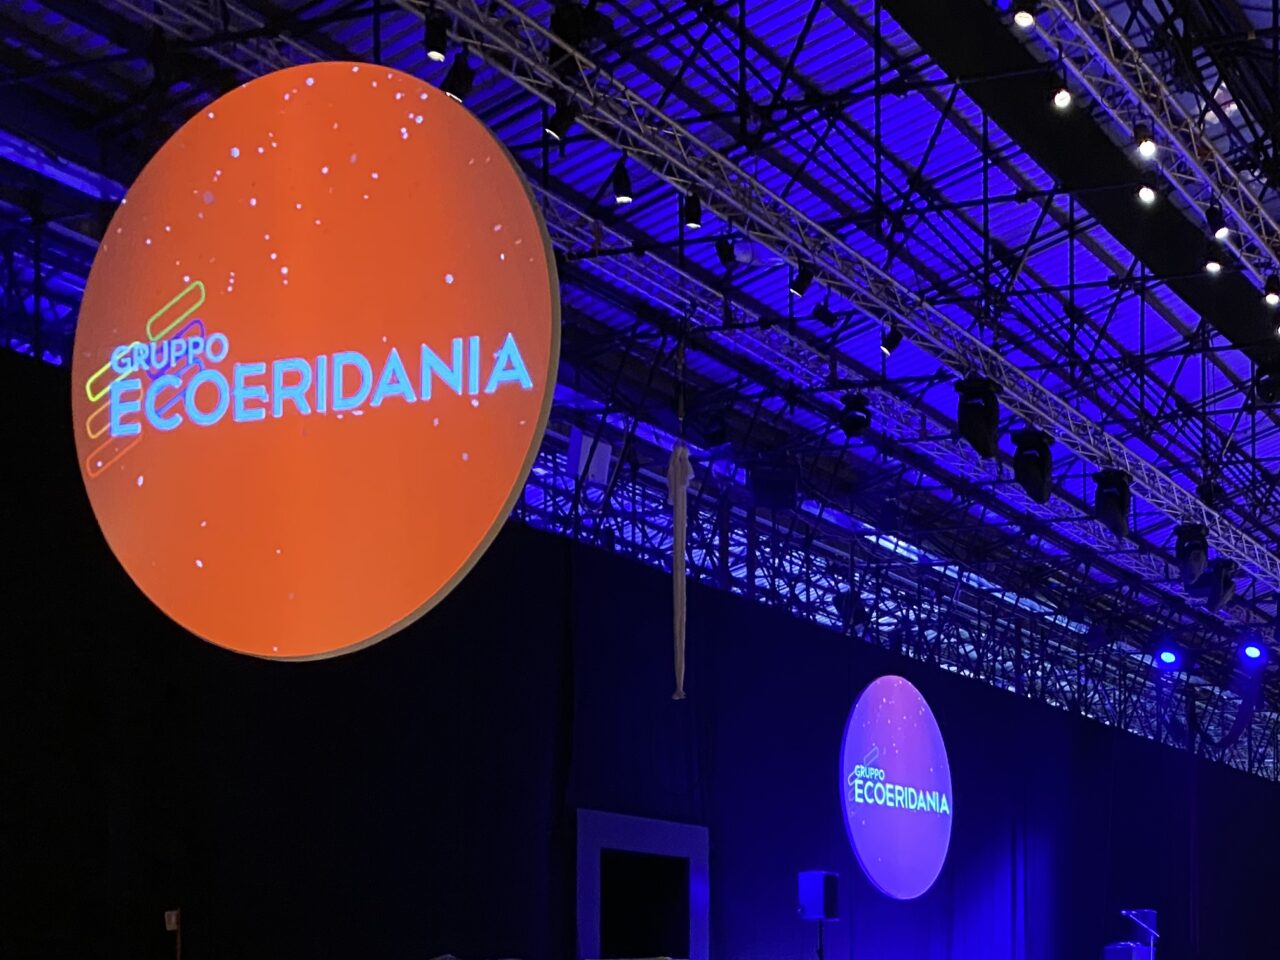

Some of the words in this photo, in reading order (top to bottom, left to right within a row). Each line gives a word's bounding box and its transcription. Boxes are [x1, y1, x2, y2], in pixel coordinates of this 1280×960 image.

[111, 332, 230, 374] GRUPPO
[108, 332, 534, 437] ECOERIDANIA
[854, 764, 885, 781] GRUPPO
[854, 778, 950, 815] ECOERIDANIA
